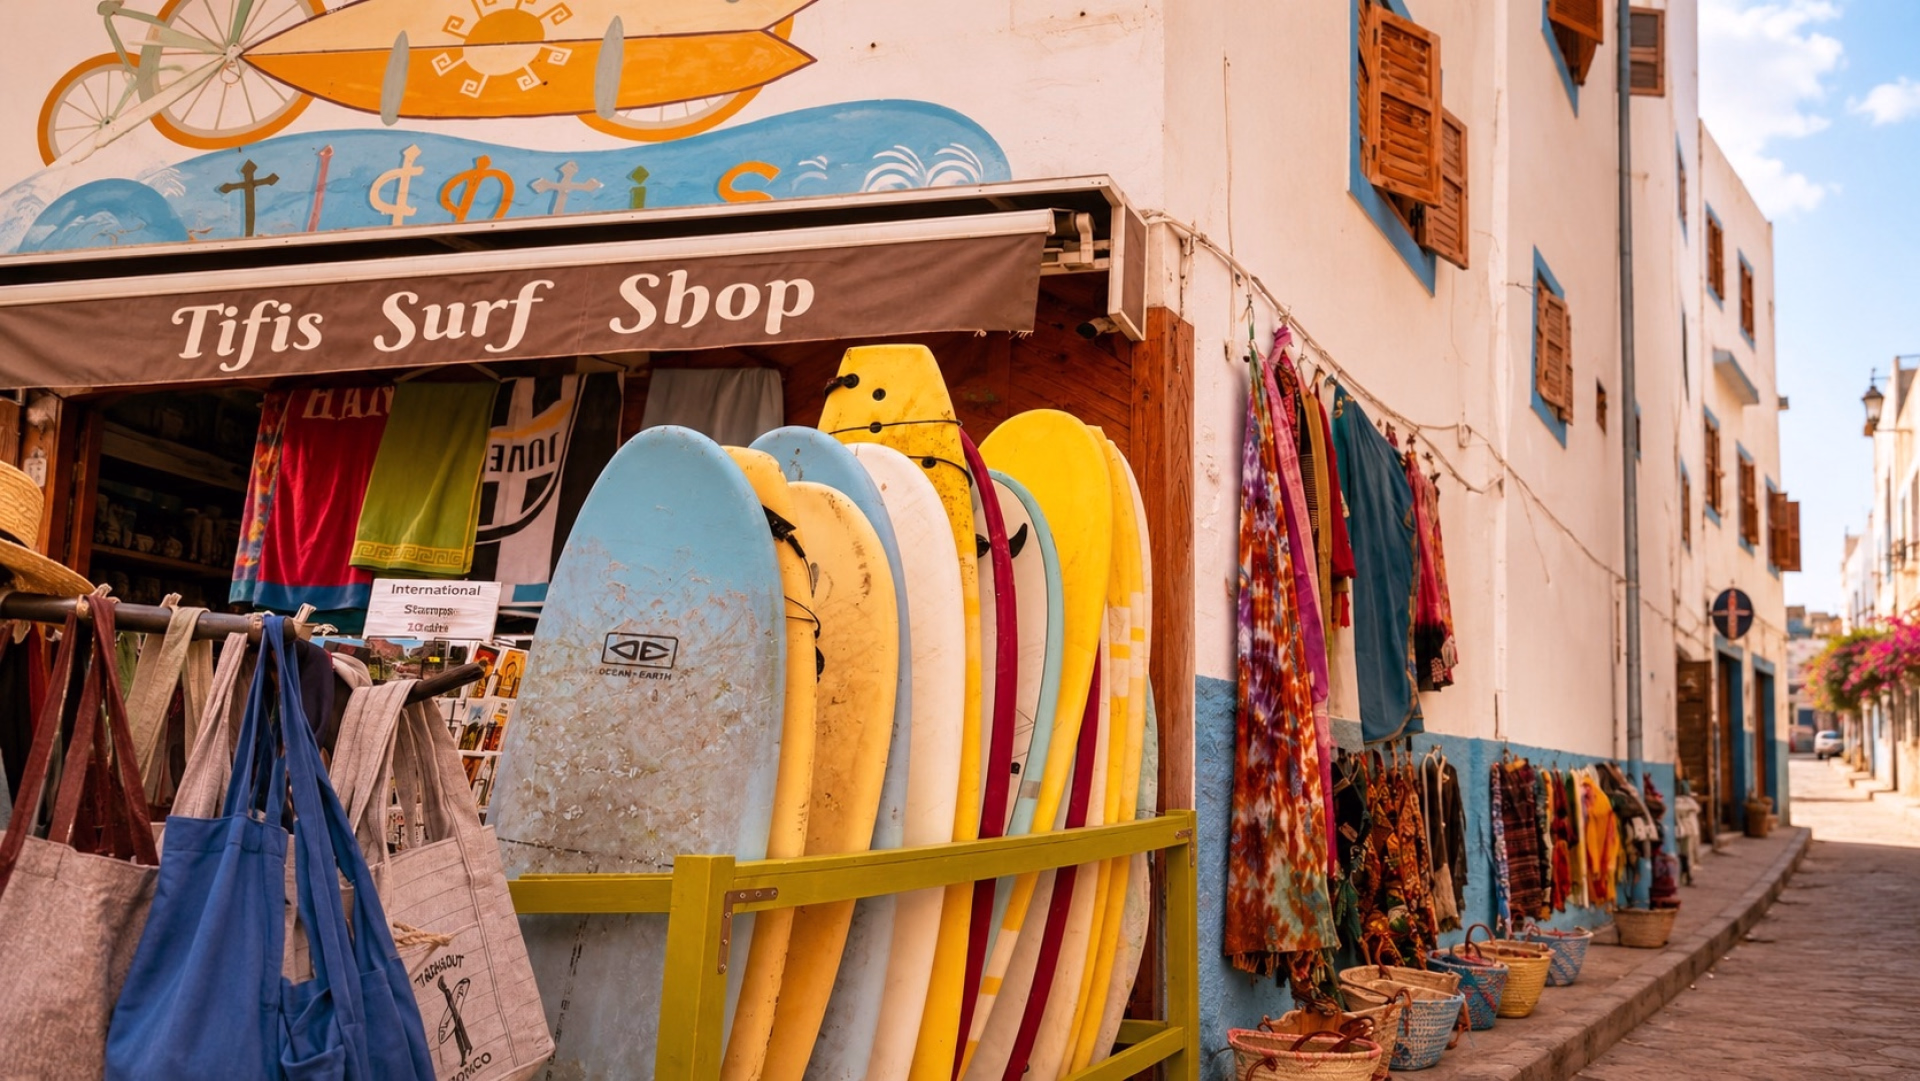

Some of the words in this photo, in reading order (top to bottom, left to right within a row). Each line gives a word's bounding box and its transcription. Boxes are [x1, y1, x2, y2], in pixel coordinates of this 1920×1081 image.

[170, 299, 324, 372] Tifis
[373, 279, 555, 353] Surf
[609, 269, 815, 335] Shop
[483, 432, 560, 473] JUVE
[391, 583, 482, 596] International
[639, 670, 673, 681] EARTH
